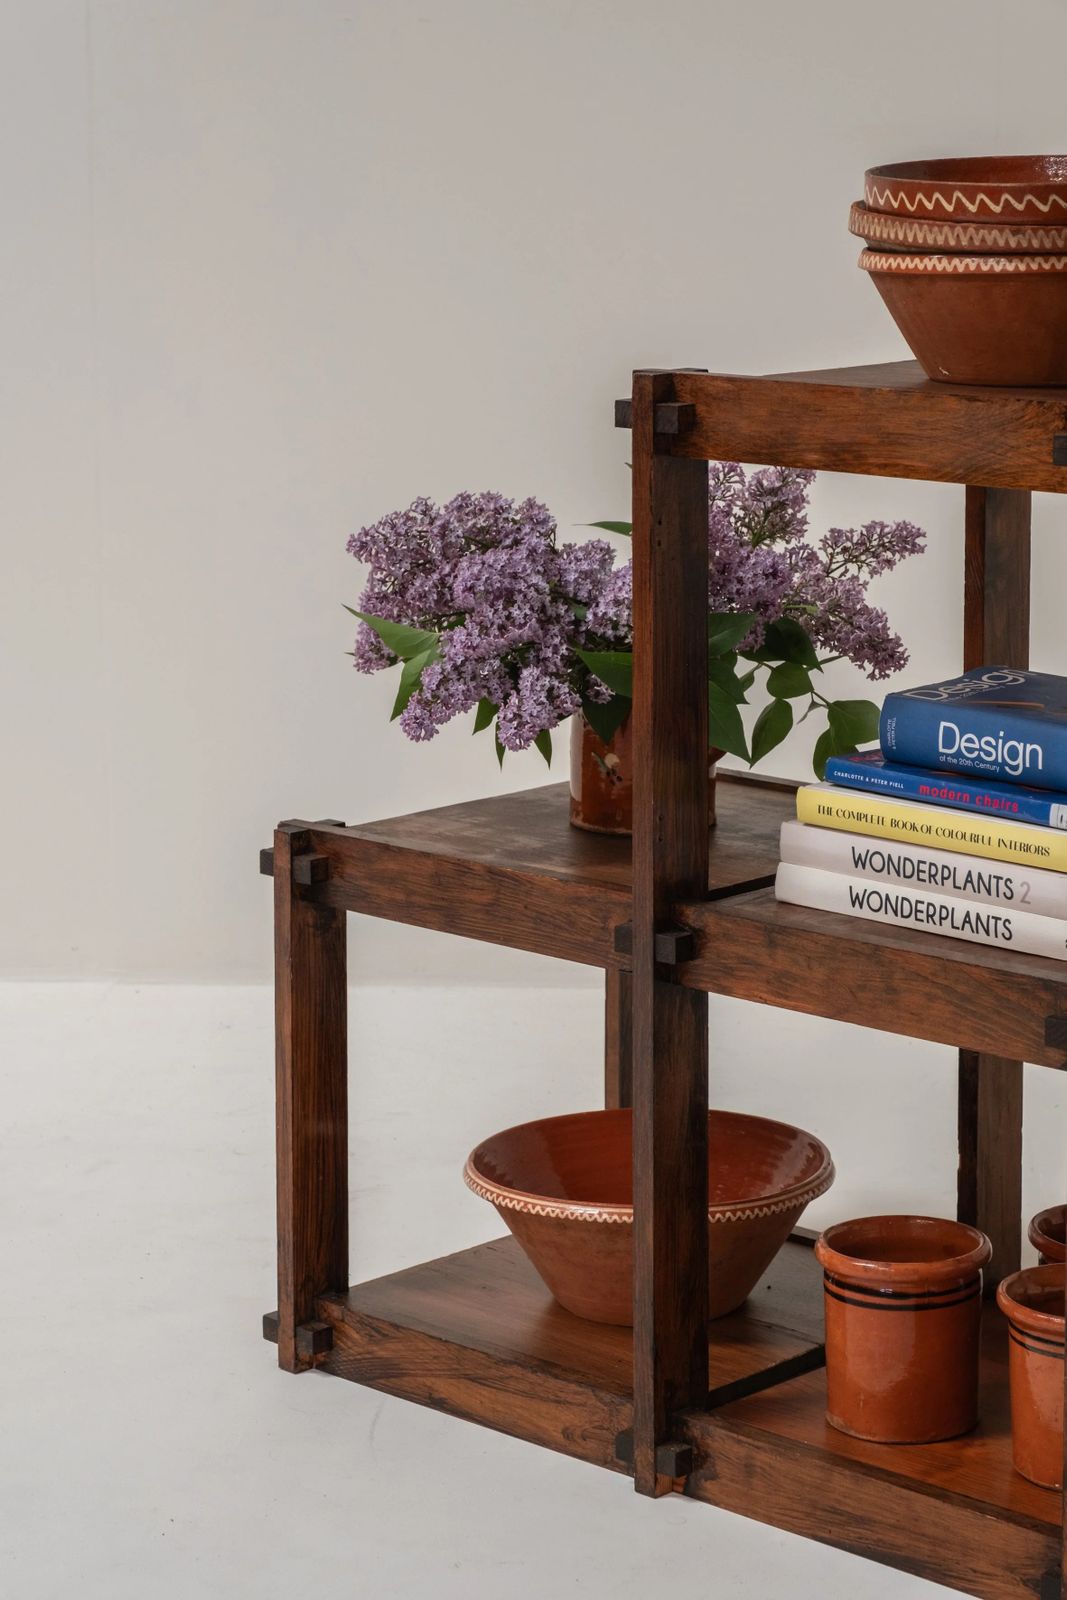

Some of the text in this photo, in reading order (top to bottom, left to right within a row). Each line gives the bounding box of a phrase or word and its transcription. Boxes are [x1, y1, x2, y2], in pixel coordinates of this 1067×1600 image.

[938, 721, 1043, 775] Design
[939, 755, 1000, 773] of the 20th Century
[833, 770, 864, 781] CHARLOTTE
[889, 781, 904, 789] FIELL
[919, 784, 1019, 813] modern chairs
[817, 804, 1050, 857] THE COMPLETE BOOK OF COLOURFUL INTERIORS
[851, 846, 1031, 904] WONDERPLANTS 2
[849, 885, 1013, 941] WONDERPLANTS
